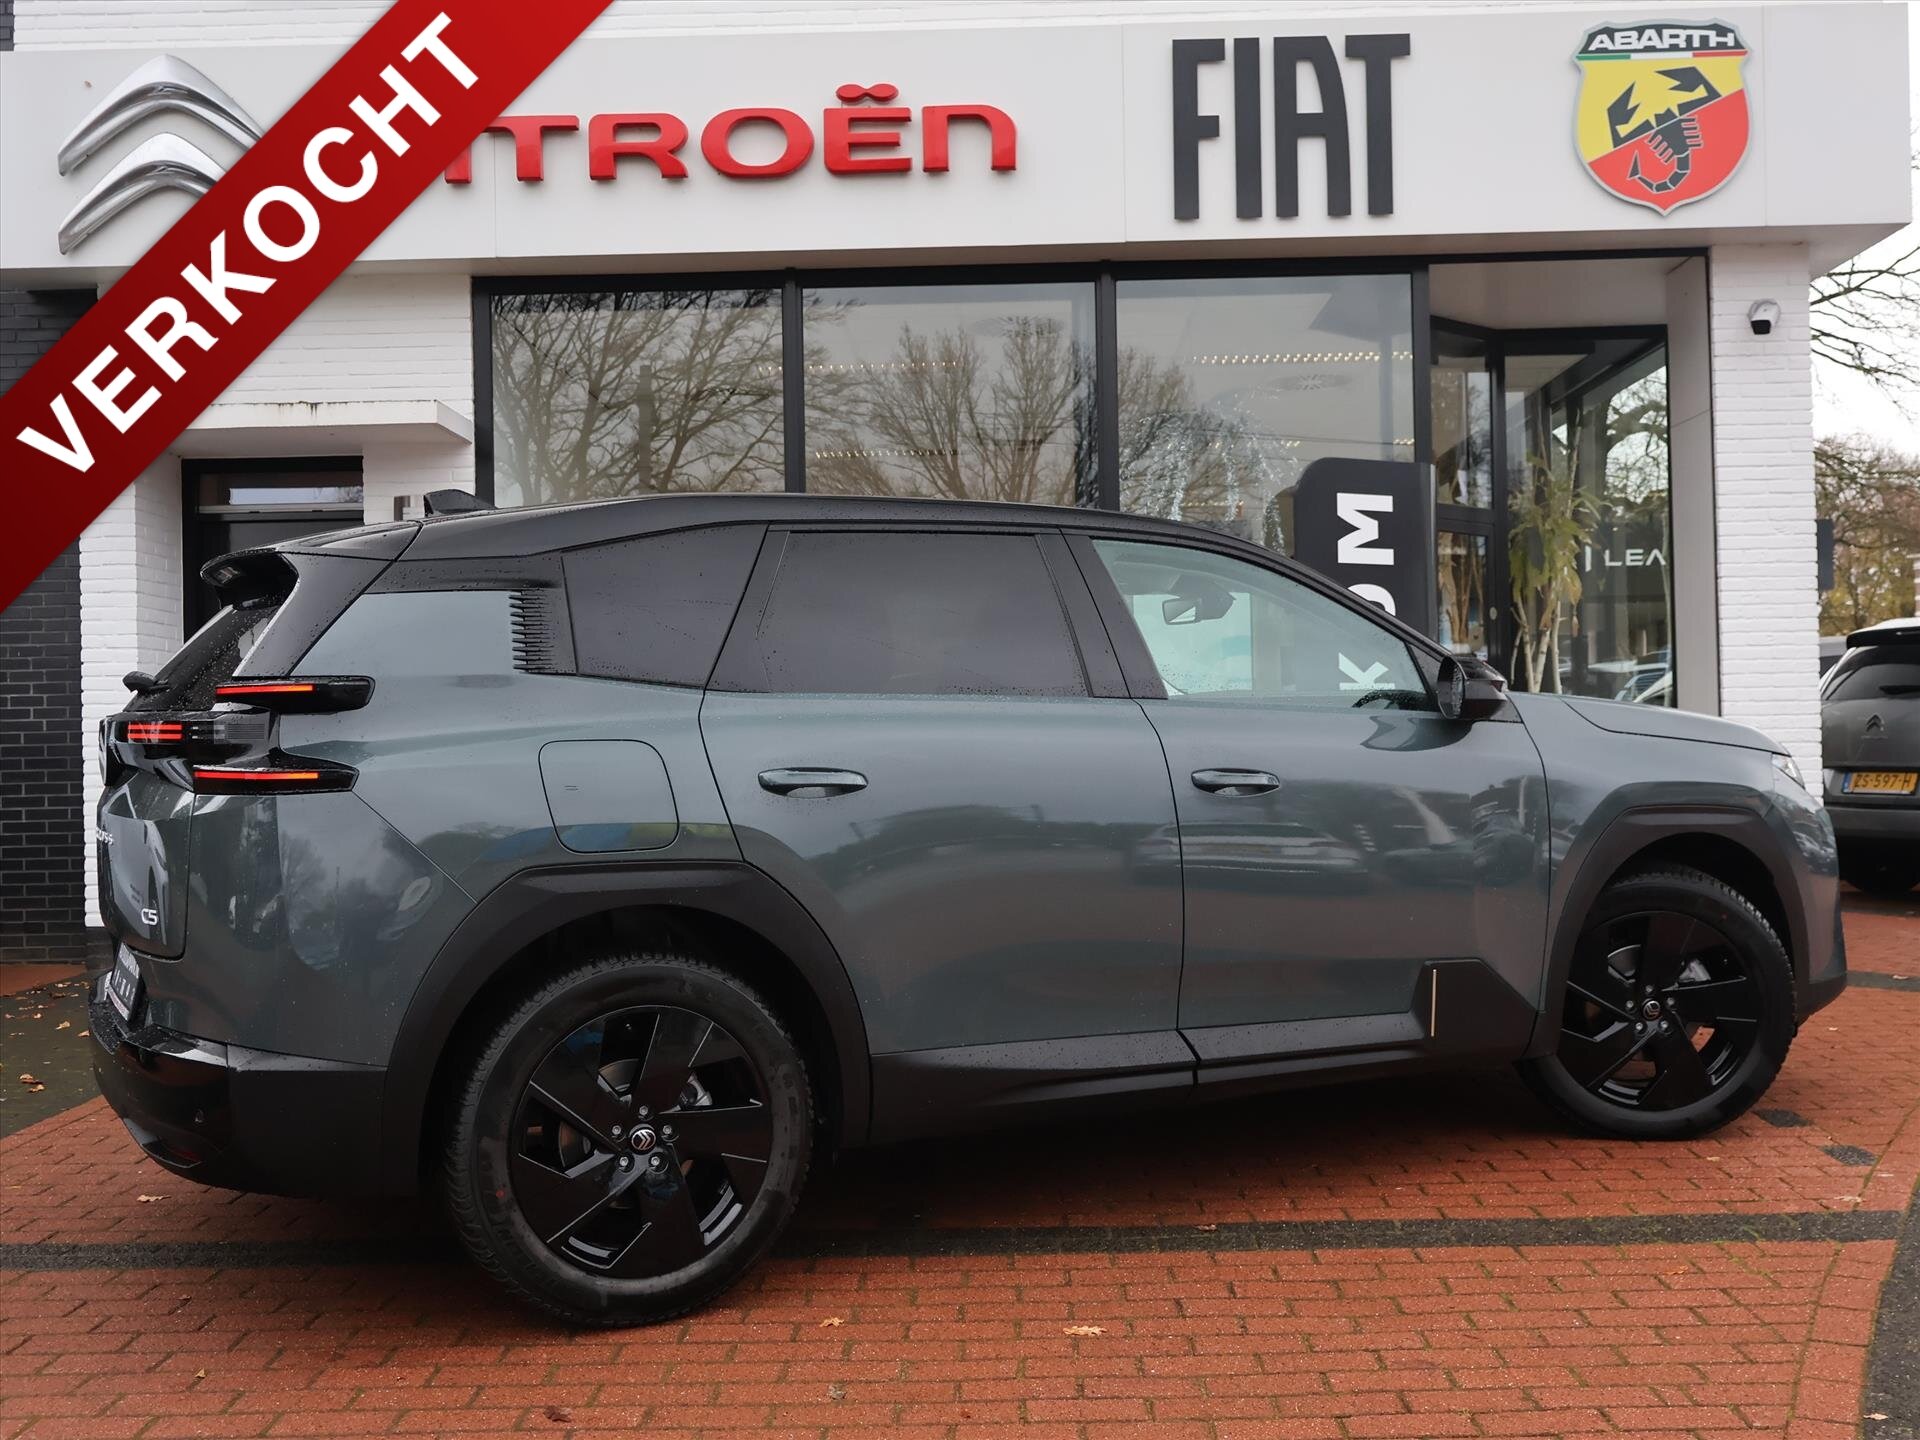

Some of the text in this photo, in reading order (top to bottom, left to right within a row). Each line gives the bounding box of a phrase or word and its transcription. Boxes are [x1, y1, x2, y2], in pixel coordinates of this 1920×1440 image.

[1588, 29, 1735, 51] ABARTH
[1171, 33, 1411, 221] FIAT
[141, 908, 158, 925] C5
